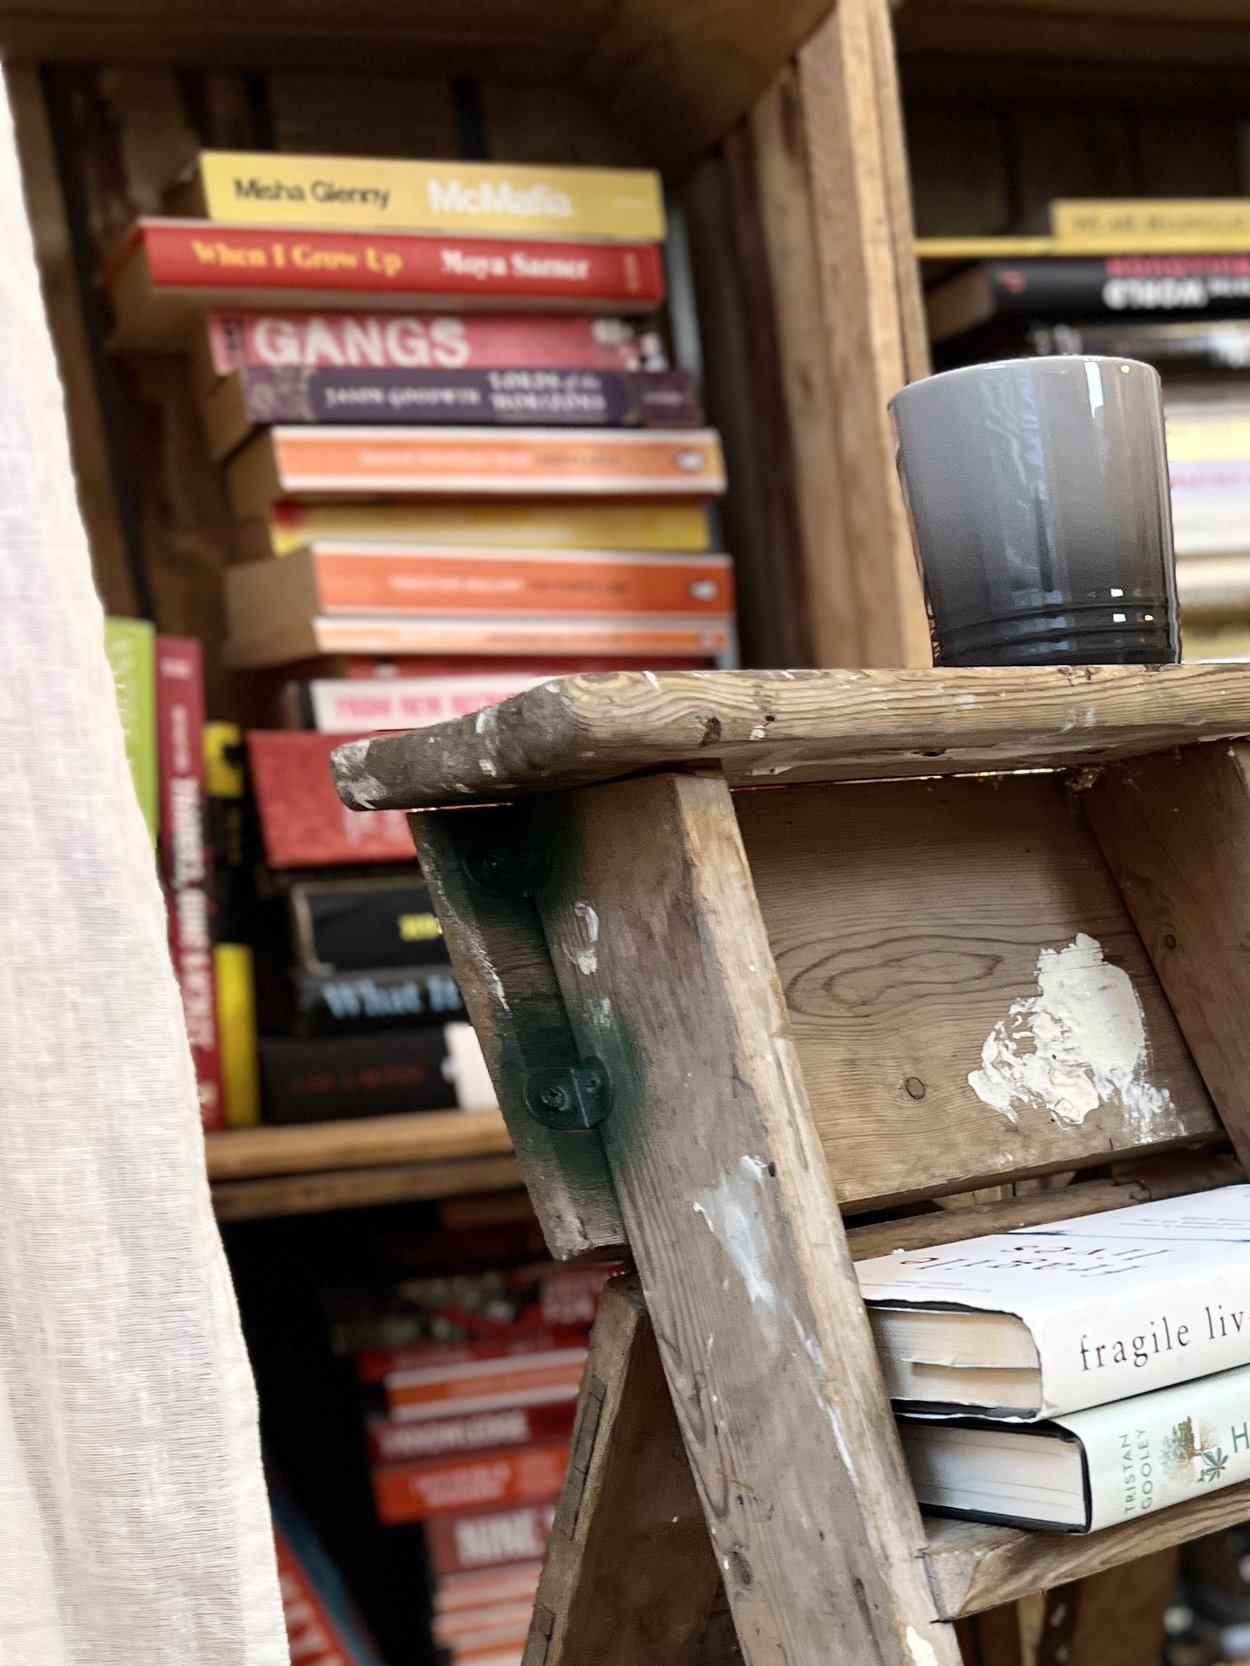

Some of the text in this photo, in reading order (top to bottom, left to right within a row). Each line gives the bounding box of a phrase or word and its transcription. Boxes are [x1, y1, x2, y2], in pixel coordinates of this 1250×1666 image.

[234, 178, 576, 220] Misha Glenny McMafia
[192, 240, 267, 268] When
[291, 245, 358, 271] Grow
[365, 246, 403, 277] Up
[440, 249, 507, 280] Moya
[253, 316, 472, 369] GANGS
[322, 978, 424, 1019] What
[1079, 1315, 1190, 1371] fragile
[1119, 1433, 1137, 1515] TRISTAN
[1135, 1428, 1154, 1510] GOOLEY
